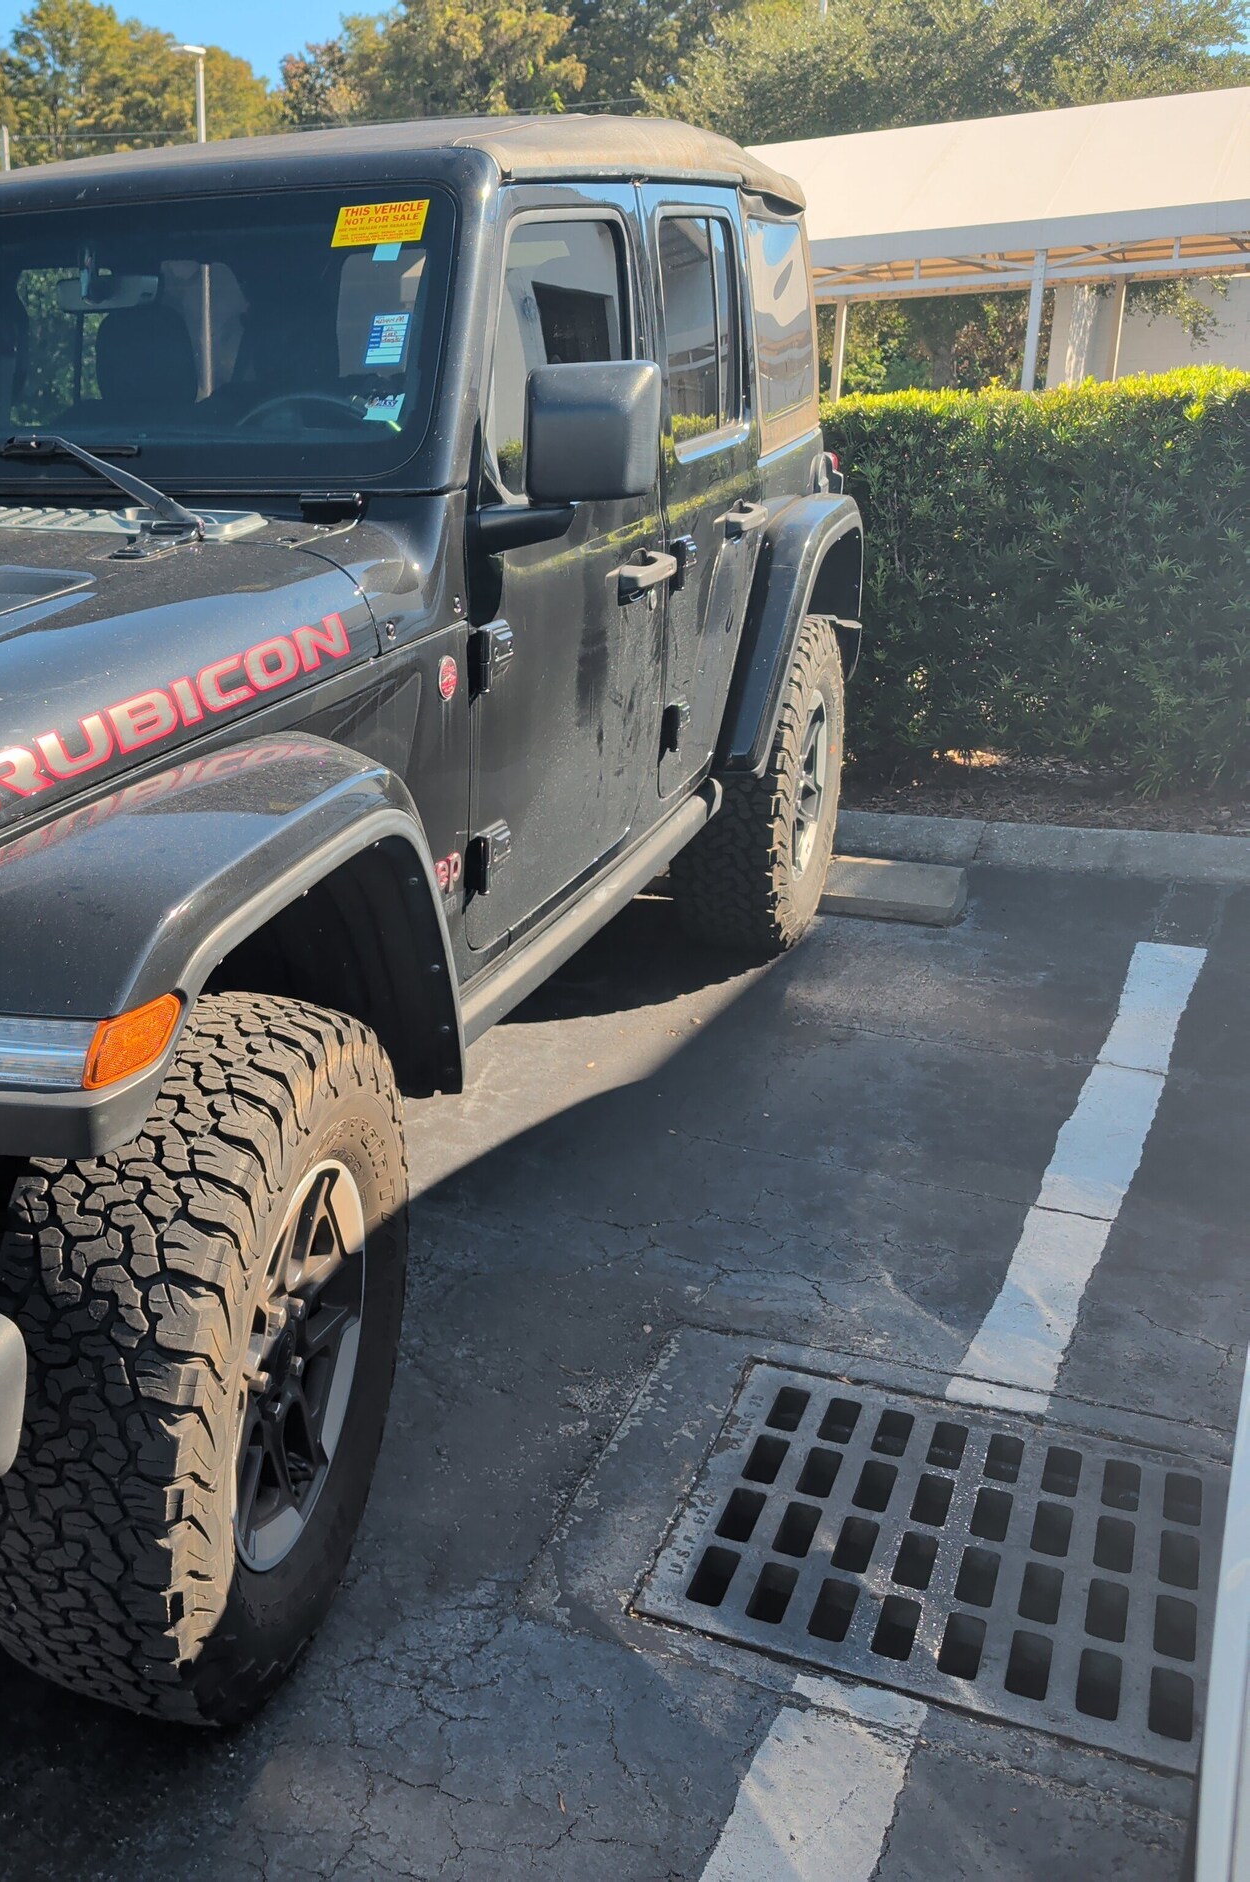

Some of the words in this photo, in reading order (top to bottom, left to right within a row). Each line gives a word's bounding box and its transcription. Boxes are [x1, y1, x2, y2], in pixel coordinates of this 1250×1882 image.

[345, 207, 370, 217] THIS
[374, 201, 425, 214] VEHICLE
[392, 213, 420, 221] SALE
[435, 851, 462, 894] ep
